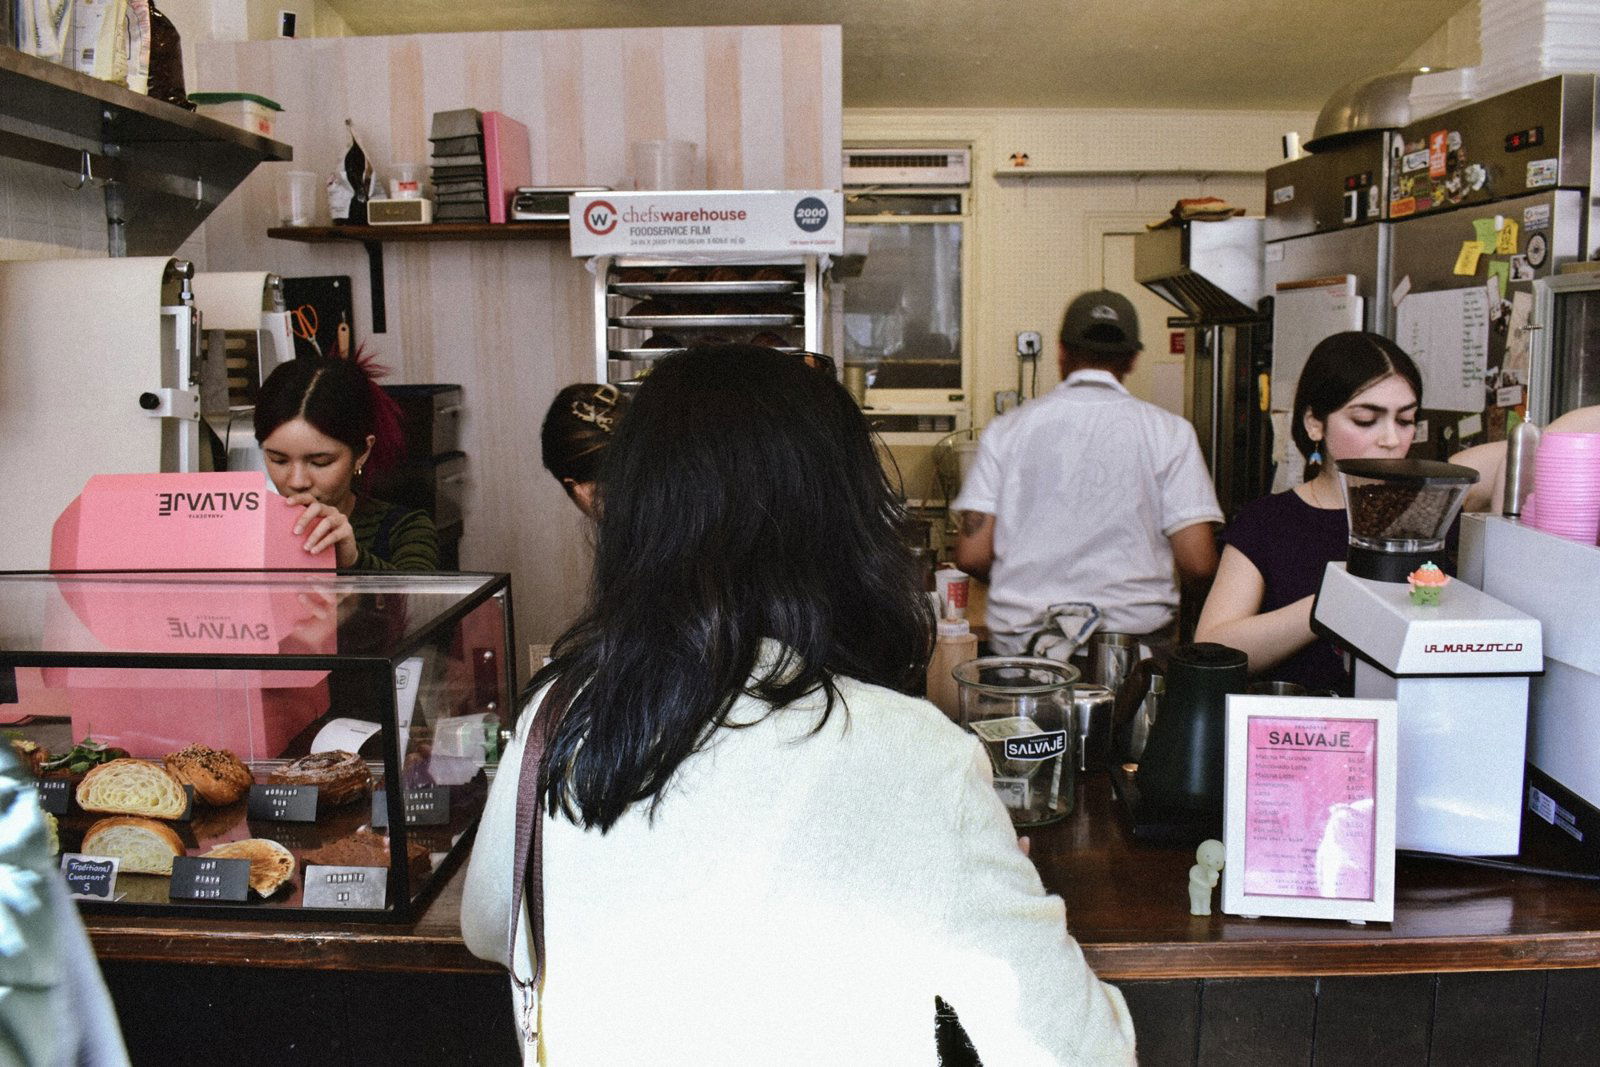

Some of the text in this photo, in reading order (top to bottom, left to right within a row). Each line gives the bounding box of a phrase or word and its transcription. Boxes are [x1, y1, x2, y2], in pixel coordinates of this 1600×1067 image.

[796, 208, 827, 218] 2000
[801, 217, 822, 225] FEET
[630, 225, 711, 236] FOODSERVICE FILM
[409, 792, 434, 800] LATTE
[70, 862, 111, 872] Traditional
[200, 861, 217, 870] UBE
[195, 875, 220, 883] PIAYA
[326, 873, 364, 883] BROWNIE
